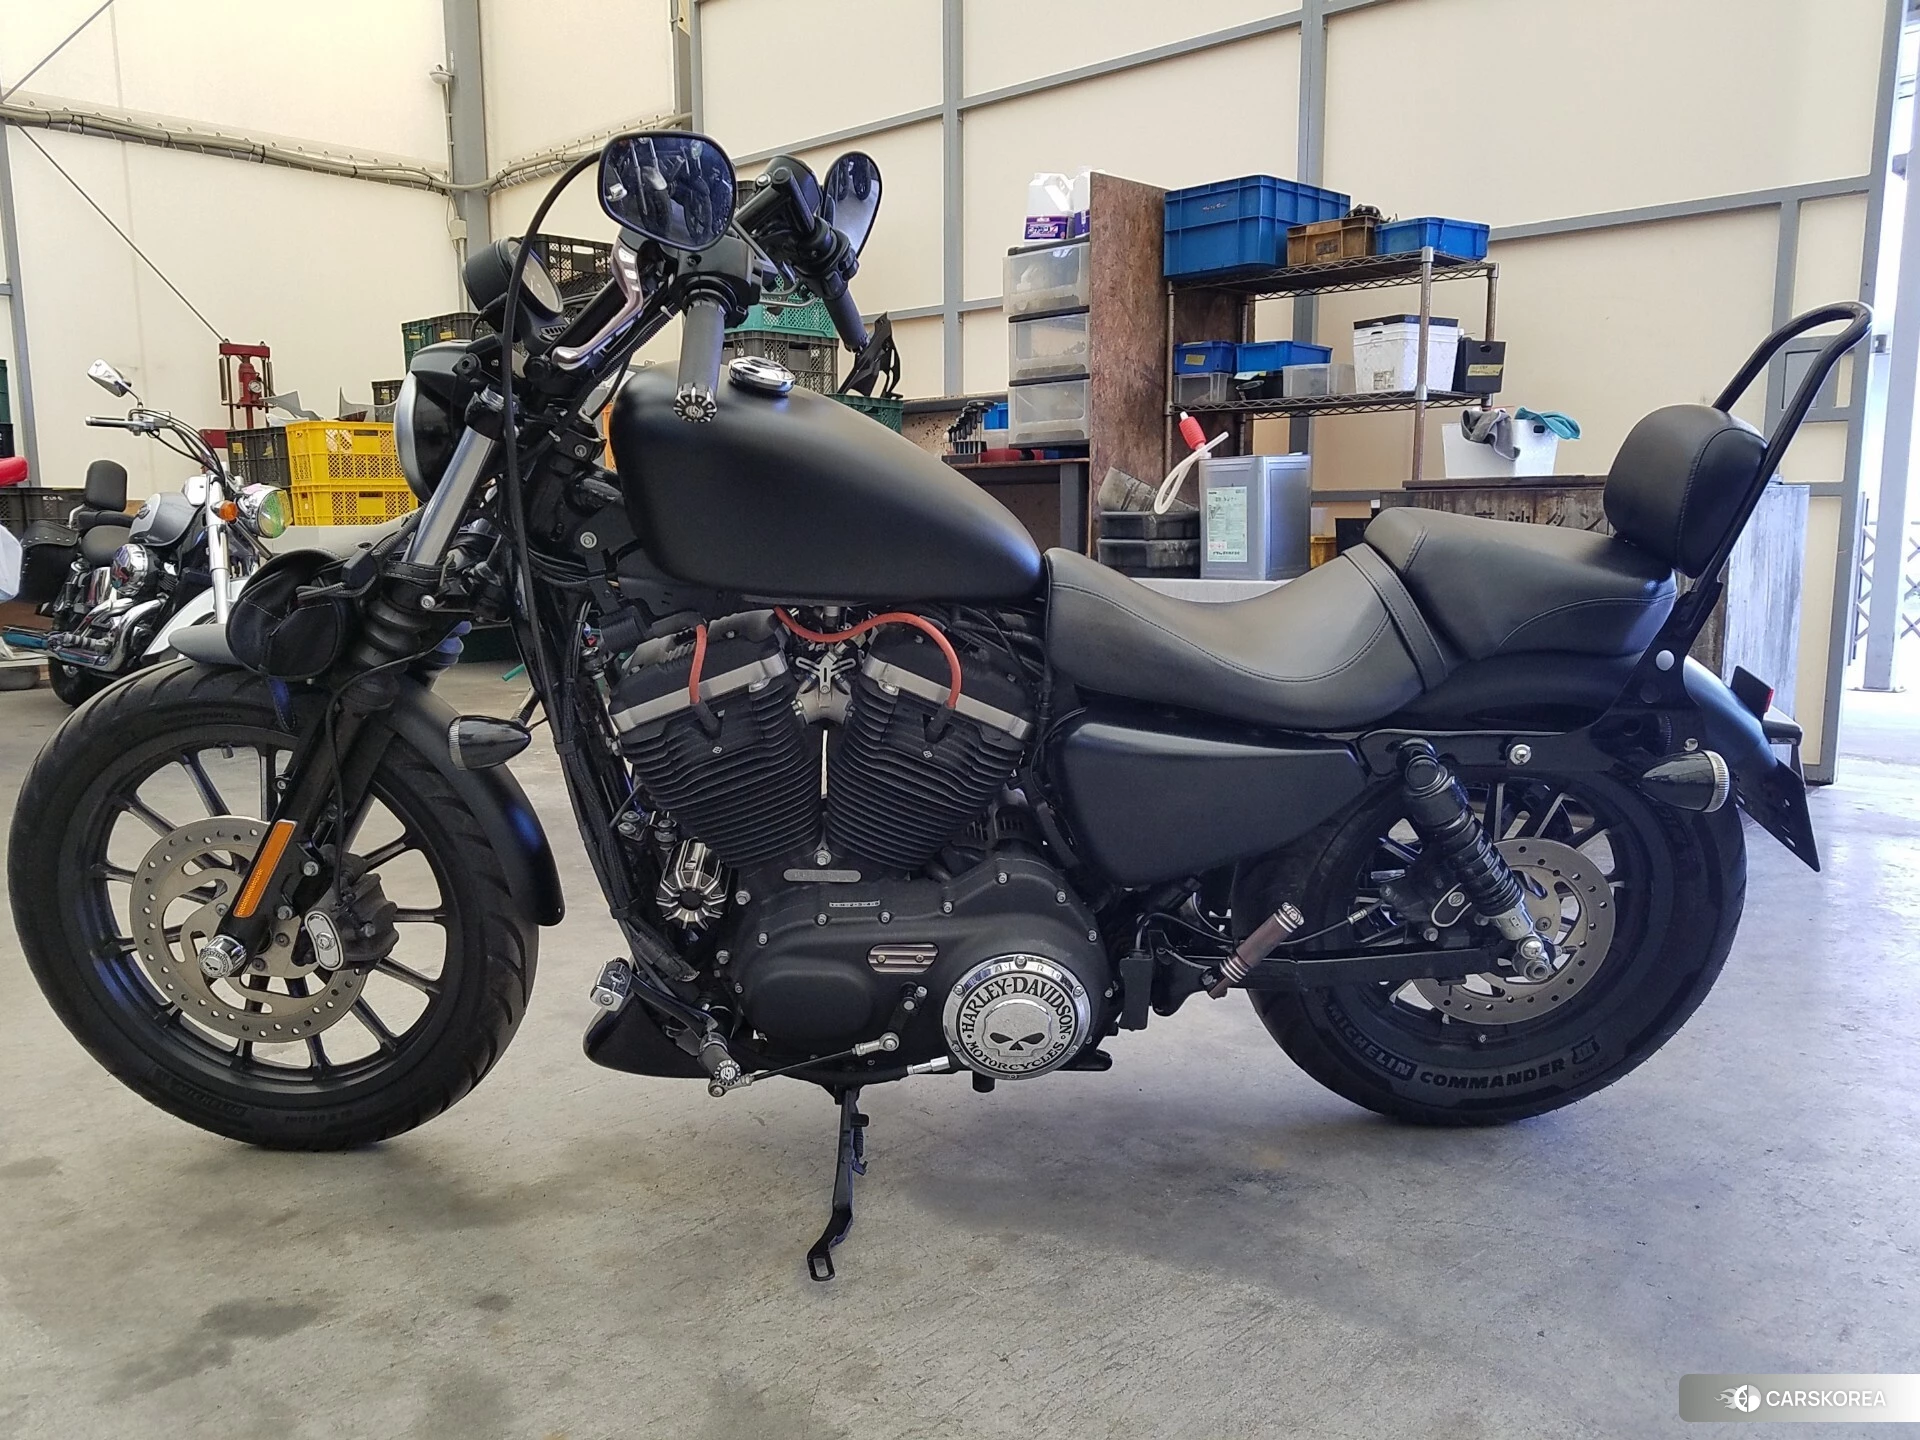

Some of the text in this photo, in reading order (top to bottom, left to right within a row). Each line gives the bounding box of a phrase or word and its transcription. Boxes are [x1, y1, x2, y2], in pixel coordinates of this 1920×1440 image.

[961, 976, 1074, 1036] HARLEY-DAVIDSON
[966, 1041, 1065, 1071] MOTORCYCLES
[1328, 1004, 1412, 1077] MICHELIN
[1420, 1058, 1566, 1090] COMMANDER
